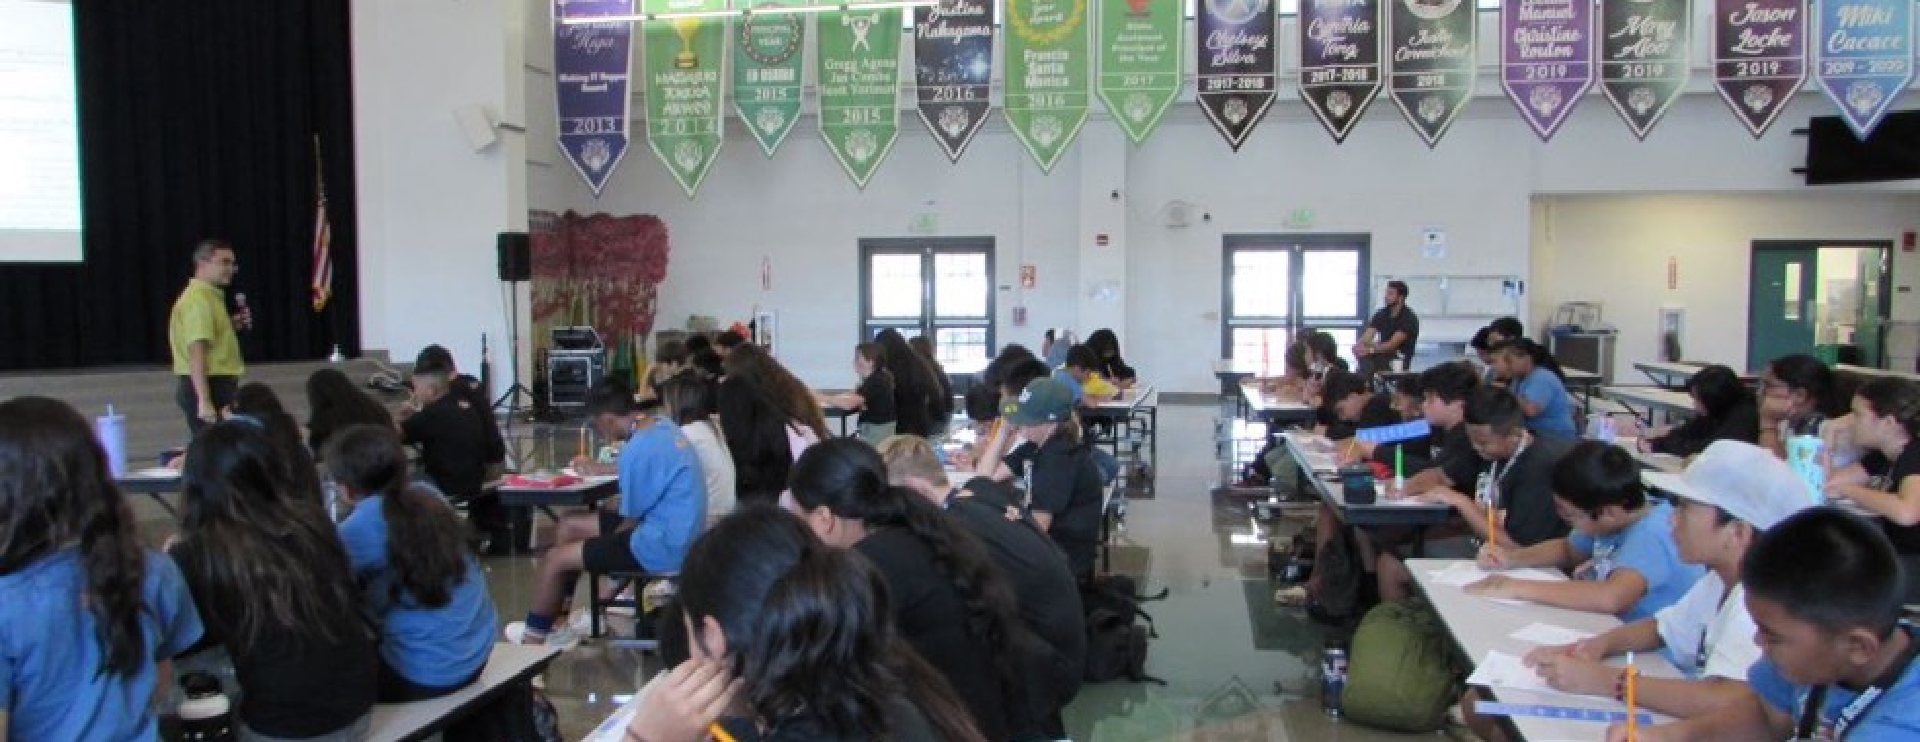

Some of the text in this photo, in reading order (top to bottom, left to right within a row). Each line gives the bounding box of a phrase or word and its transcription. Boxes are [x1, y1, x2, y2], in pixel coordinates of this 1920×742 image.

[1729, 3, 1796, 26] Jason
[1731, 27, 1792, 54] Locke
[1526, 65, 1567, 79] 2019
[1622, 64, 1664, 78] 2019
[1737, 61, 1779, 75] 2019
[1124, 76, 1154, 86] 2017
[755, 88, 787, 100] 2015
[933, 87, 974, 101] 2016
[1028, 93, 1065, 107] 2016
[843, 108, 880, 123] 2015
[573, 118, 615, 132] 2013
[661, 119, 714, 133] 2014
